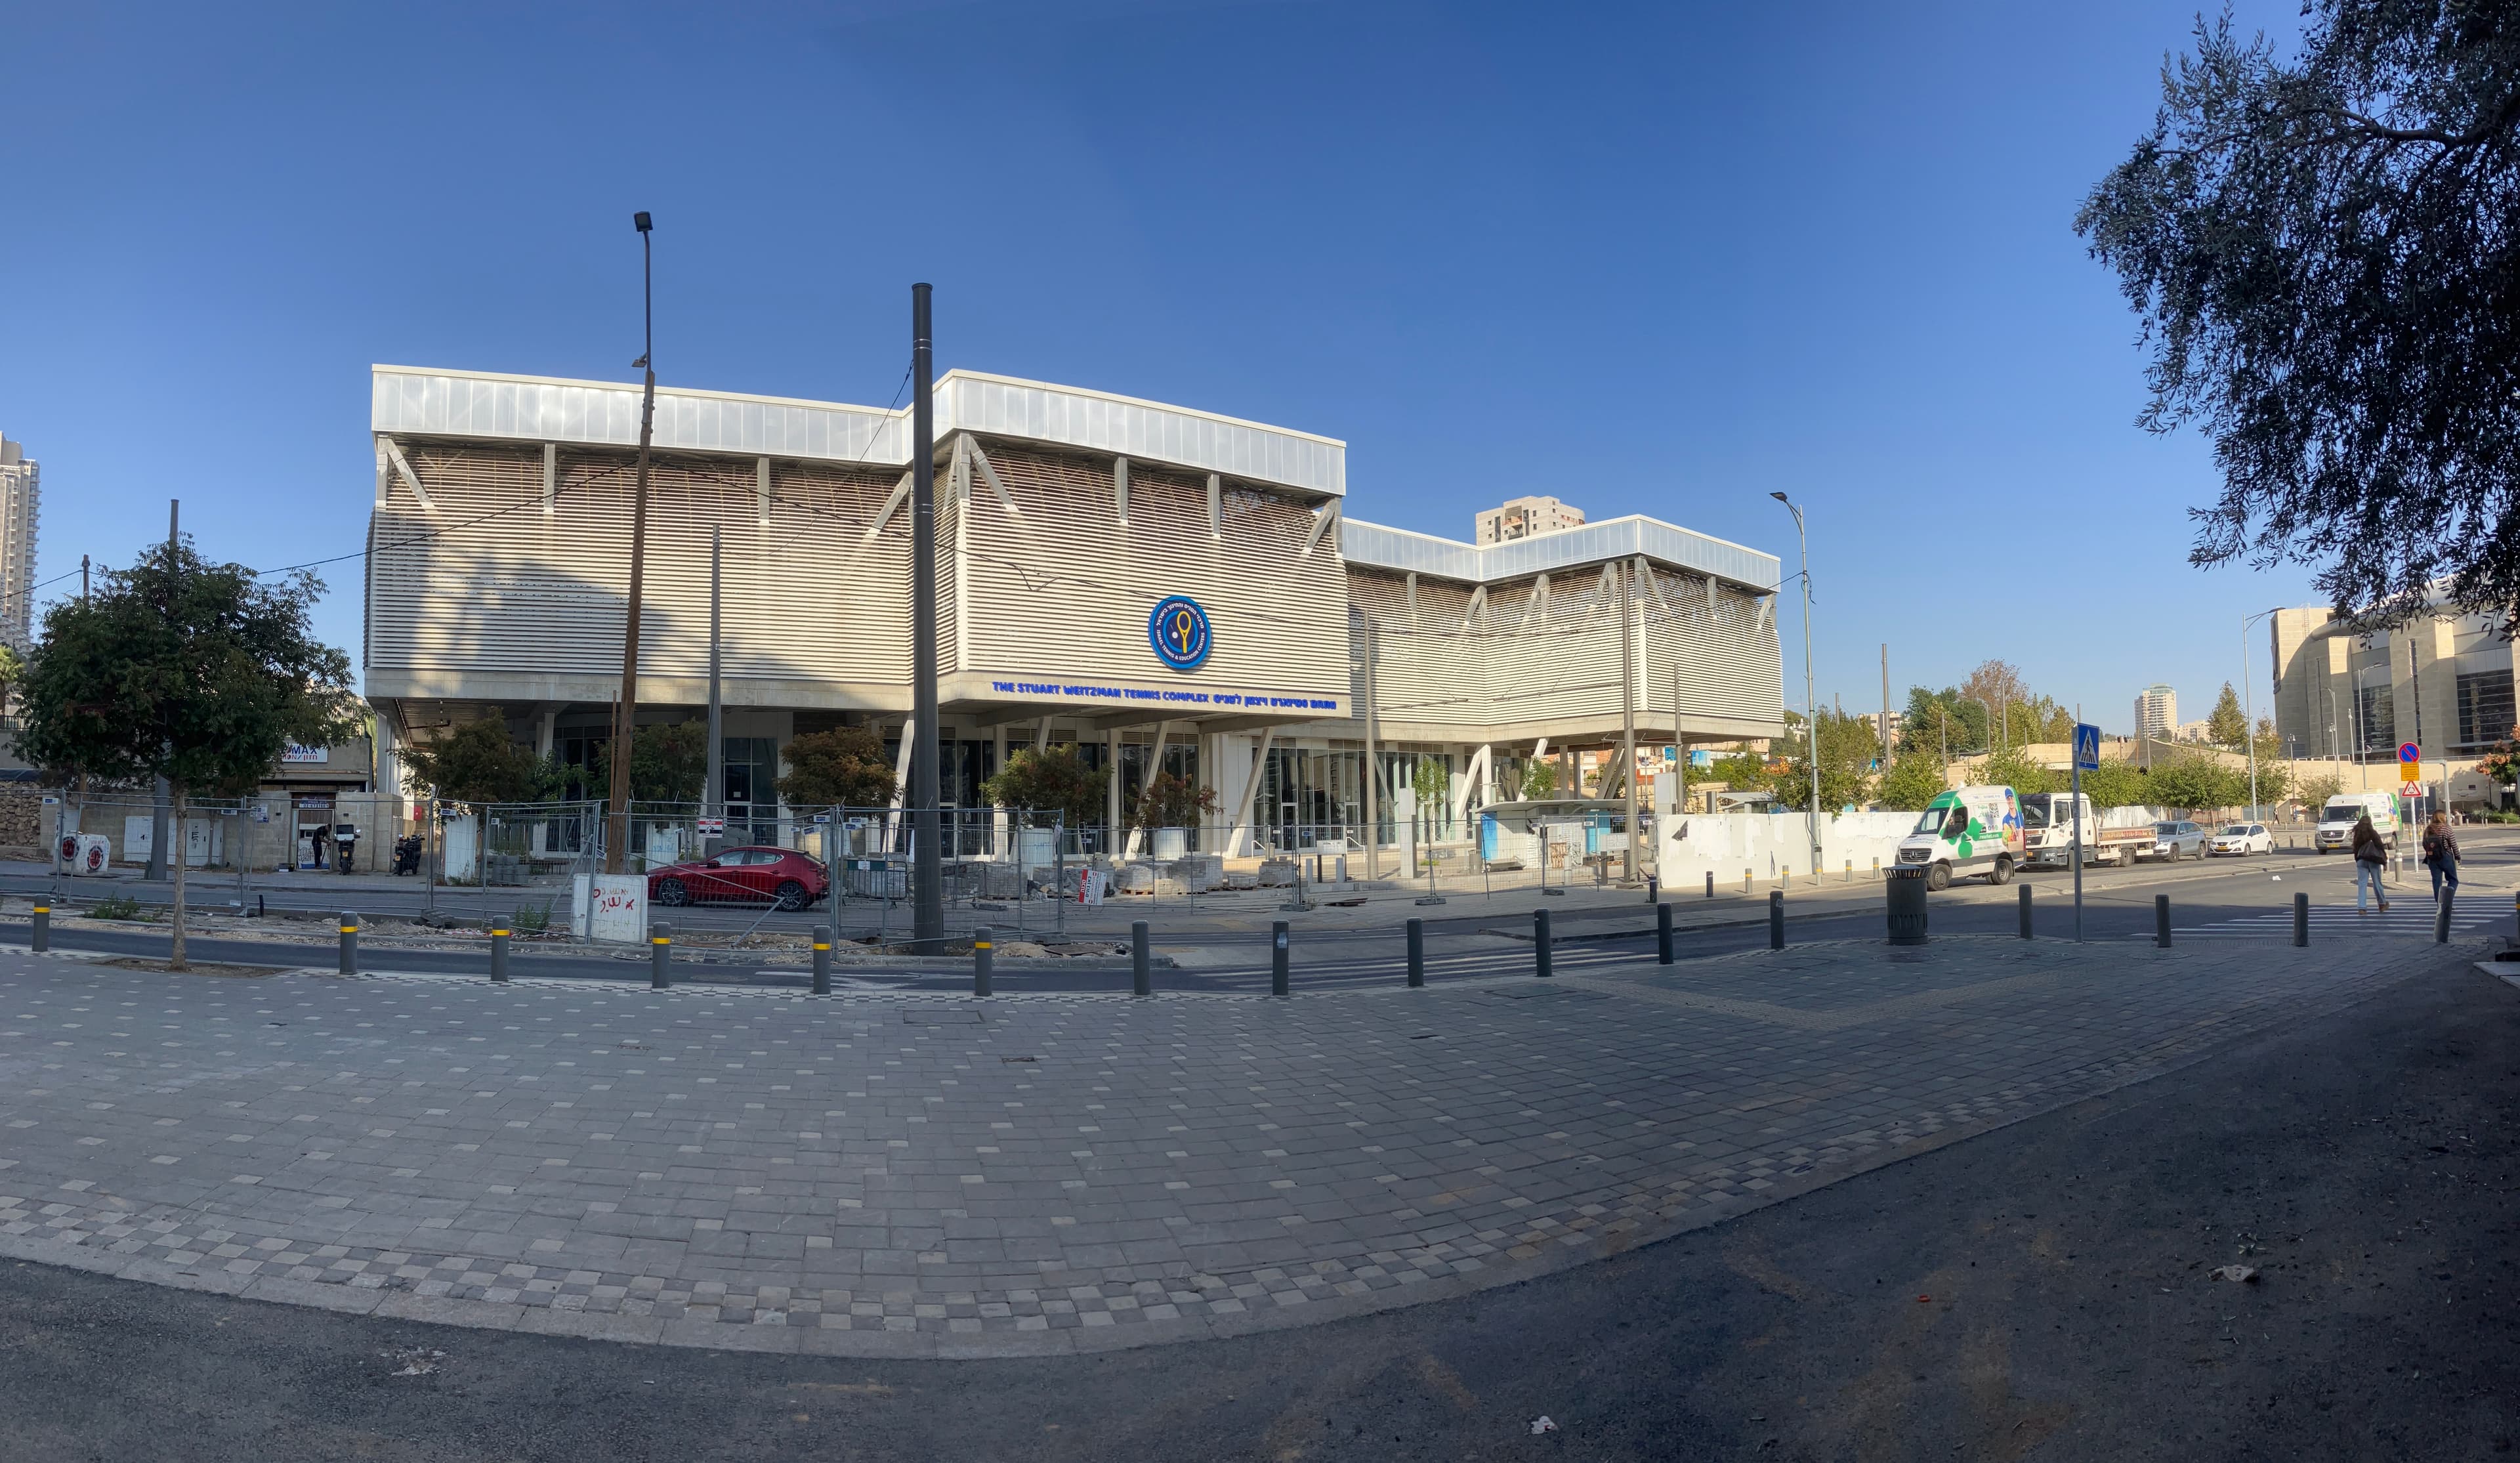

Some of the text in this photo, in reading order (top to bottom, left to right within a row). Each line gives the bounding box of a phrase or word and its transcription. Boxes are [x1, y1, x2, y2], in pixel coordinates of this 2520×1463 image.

[1184, 604, 1197, 616] הטניס
[1156, 608, 1168, 626] בישראל
[1162, 645, 1175, 658] TENNIS
[1179, 650, 1199, 661] EDUCATION
[992, 681, 1209, 703] THE STUART WEITZMAN TENNIS COMPLEX
[1213, 693, 1242, 706] לטניס
[1244, 696, 1268, 708] ויצמן
[1310, 700, 1337, 710] מתחם
